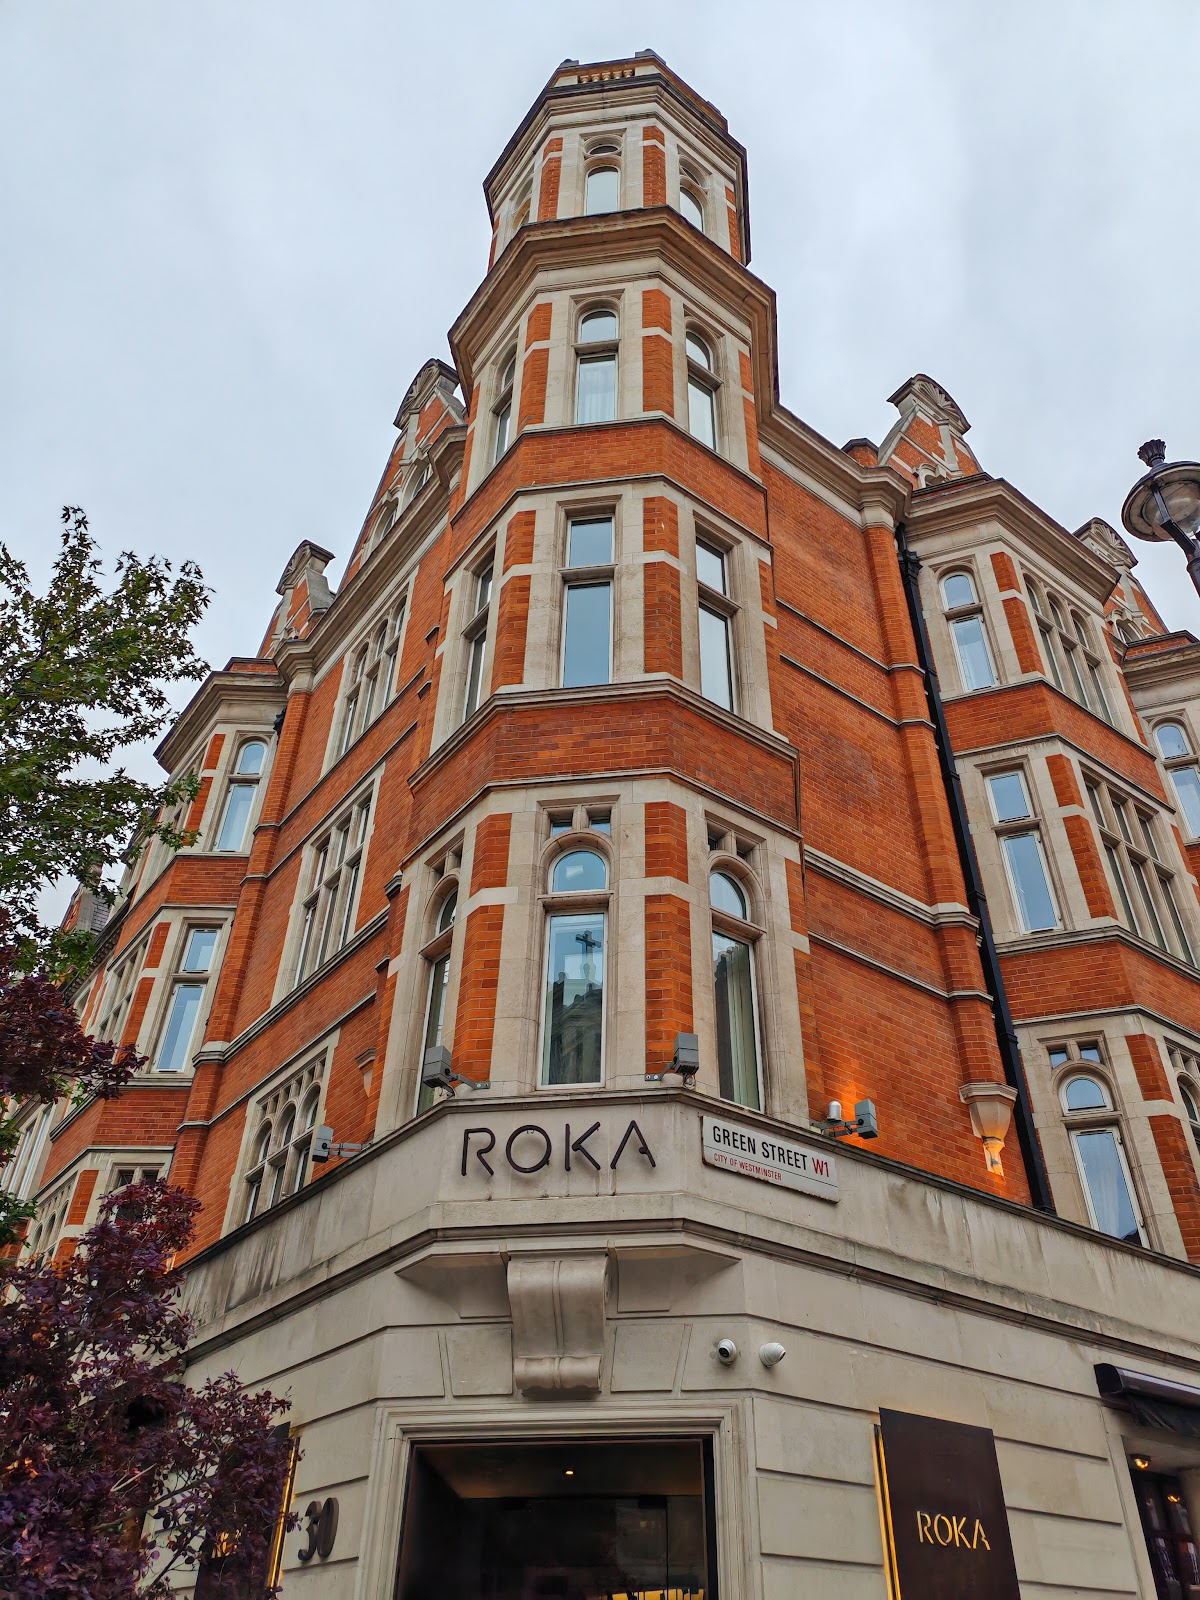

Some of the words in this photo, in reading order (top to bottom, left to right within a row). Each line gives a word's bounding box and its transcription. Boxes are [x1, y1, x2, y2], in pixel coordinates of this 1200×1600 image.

[461, 1119, 656, 1176] ROKA
[712, 1125, 756, 1155] GREEN
[761, 1141, 808, 1171] STREET
[812, 1157, 830, 1177] W1
[713, 1152, 728, 1164] CITY
[729, 1157, 738, 1167] OF
[739, 1160, 782, 1181] WESTMINSTER
[298, 1497, 339, 1561] 30
[916, 1510, 991, 1551] ROKA
